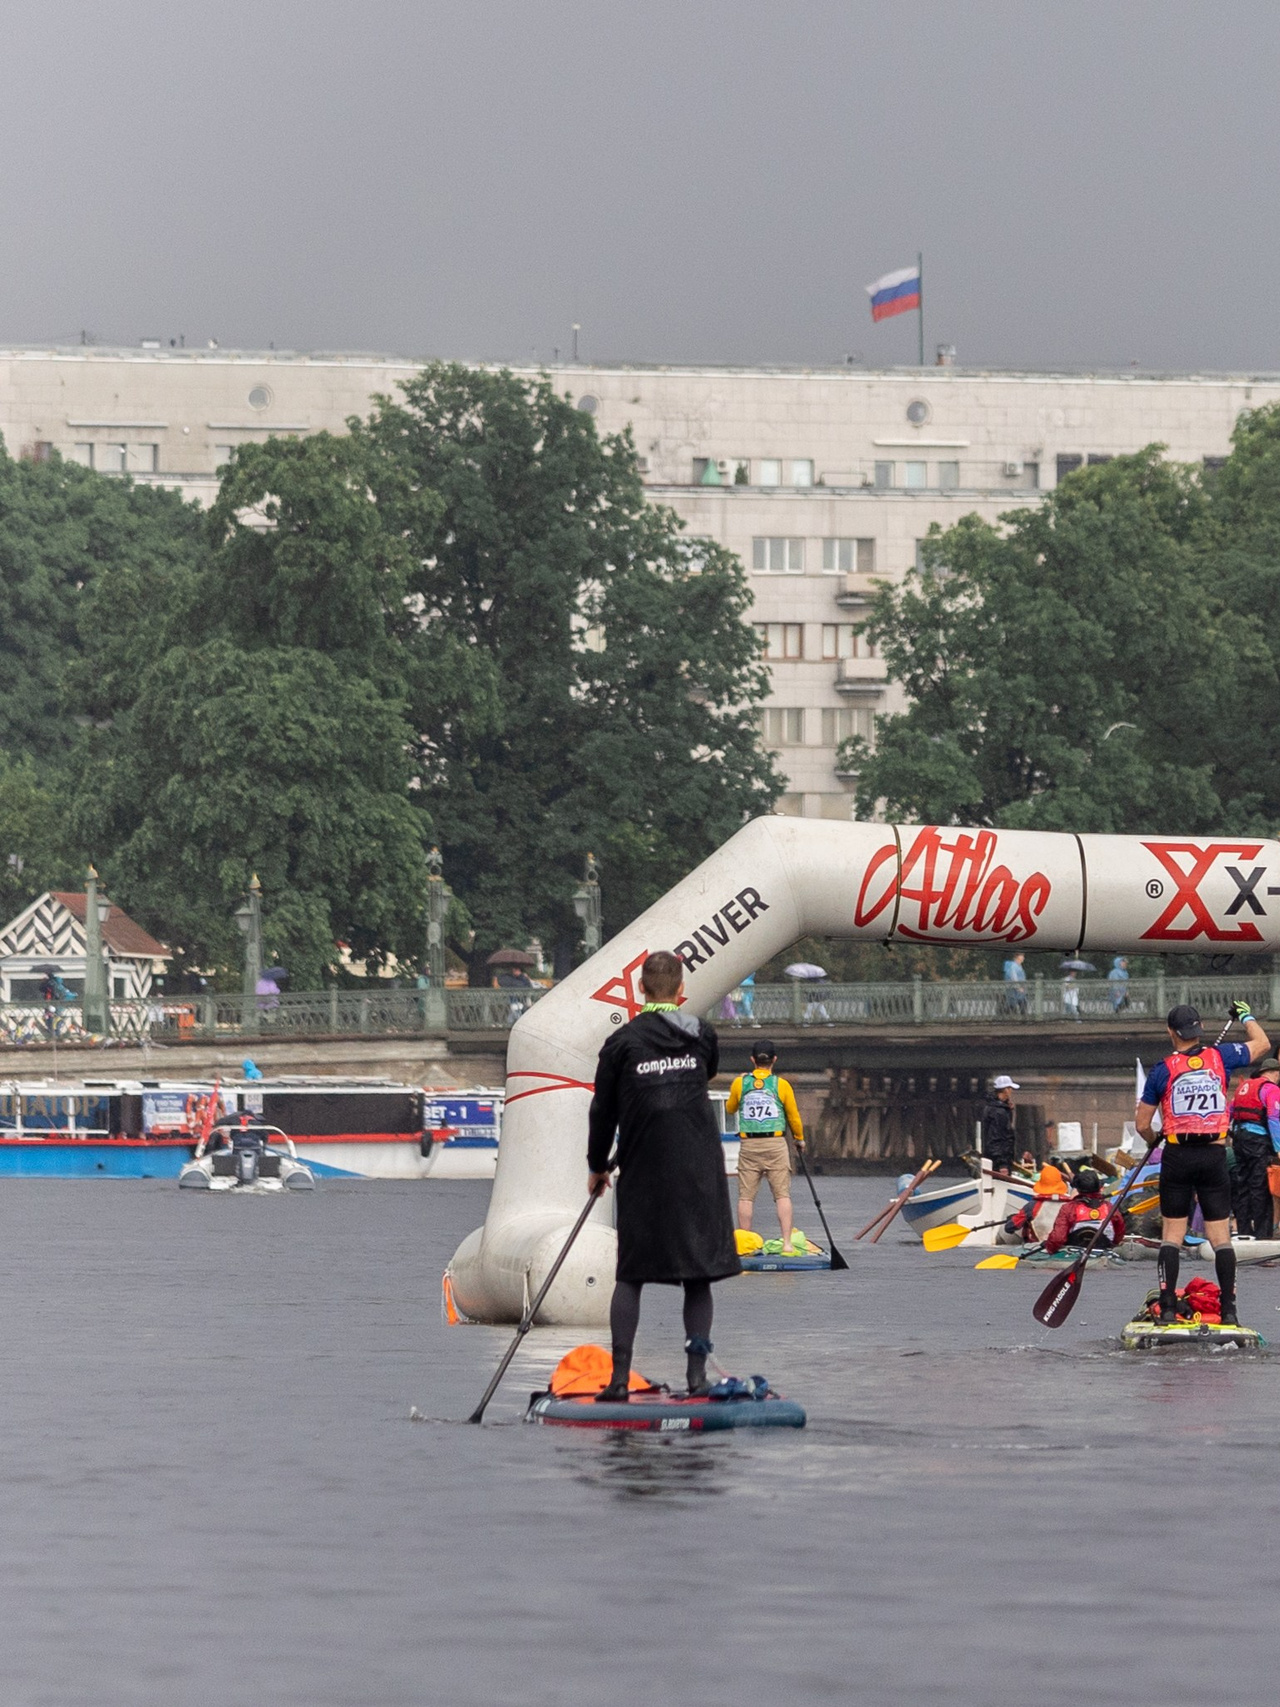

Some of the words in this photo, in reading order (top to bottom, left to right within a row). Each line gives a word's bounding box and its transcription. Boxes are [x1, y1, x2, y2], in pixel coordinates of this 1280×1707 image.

[854, 825, 1052, 943] Atlas
[673, 886, 771, 974] RIVER
[636, 1053, 697, 1076] complexis
[748, 1106, 772, 1118] 374
[1184, 1093, 1218, 1111] 721
[1053, 1281, 1071, 1308] PADDLE
